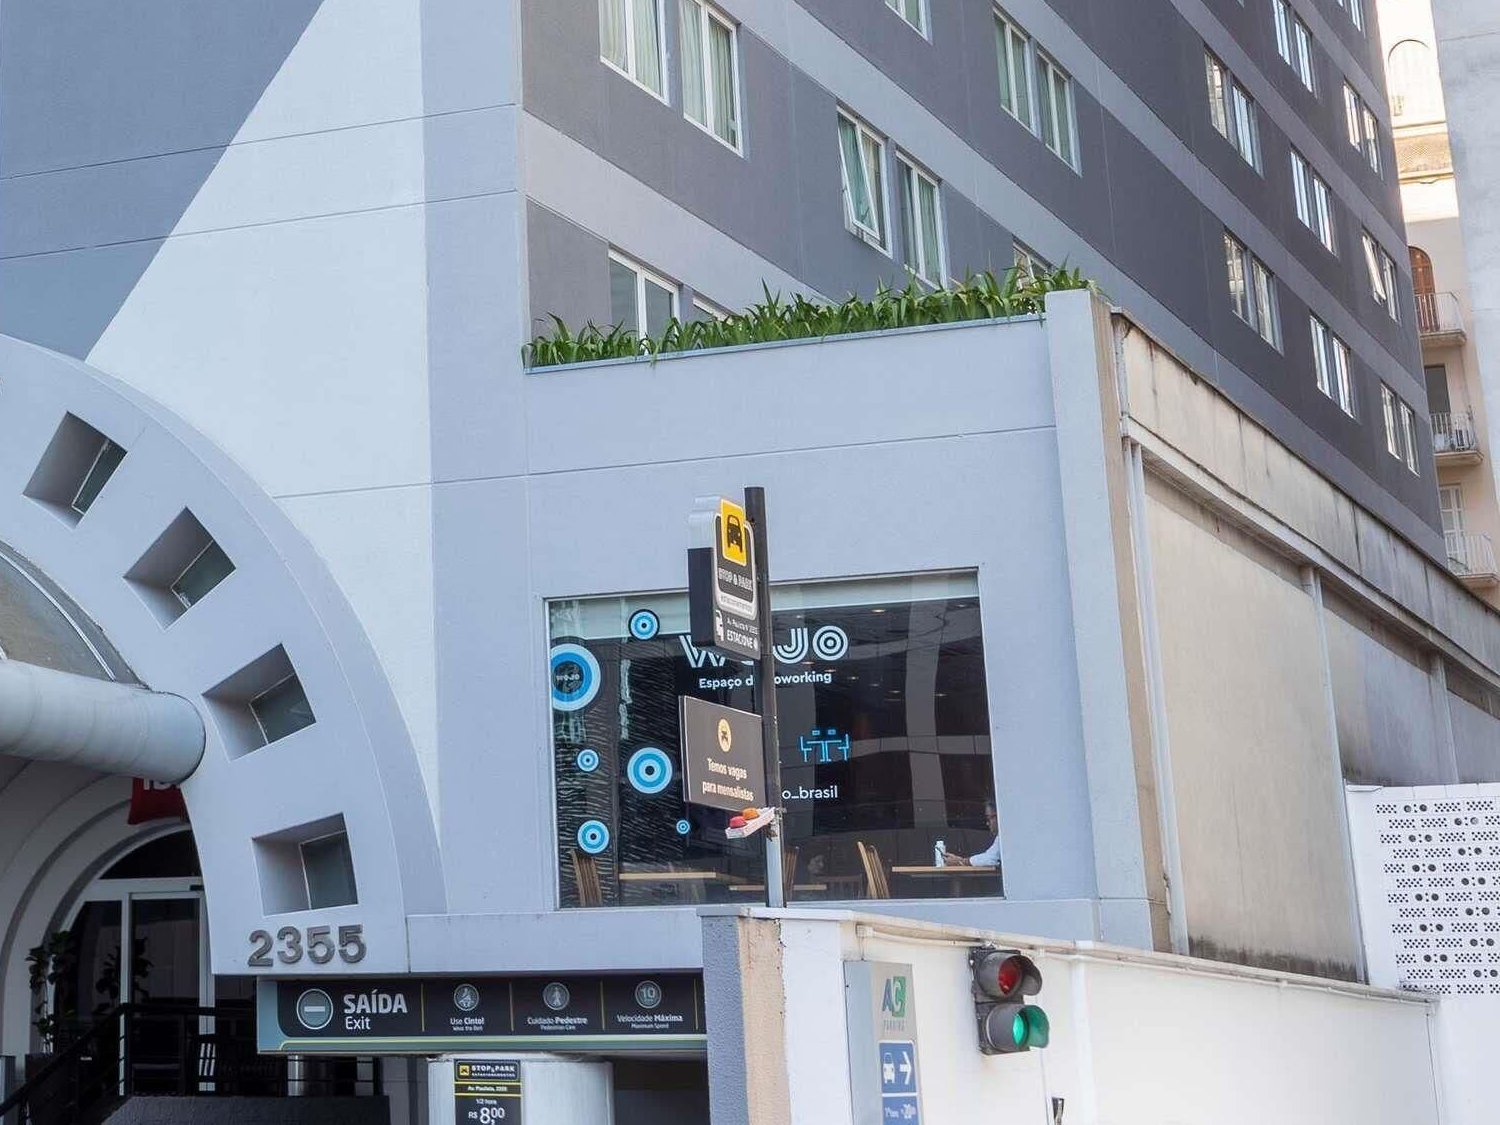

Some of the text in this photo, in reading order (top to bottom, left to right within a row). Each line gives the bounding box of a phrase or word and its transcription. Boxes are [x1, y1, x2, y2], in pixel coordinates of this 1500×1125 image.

[699, 672, 832, 690] Espaço d oworking
[707, 757, 747, 780] Temos vagas
[702, 781, 754, 801] para mensalistas
[247, 924, 367, 967] 2355
[343, 989, 408, 1014] SAÍDA
[345, 1016, 371, 1030] Exit
[527, 1016, 588, 1025] Cuidado Pedestre
[617, 1011, 683, 1023] Velocidade Máxima
